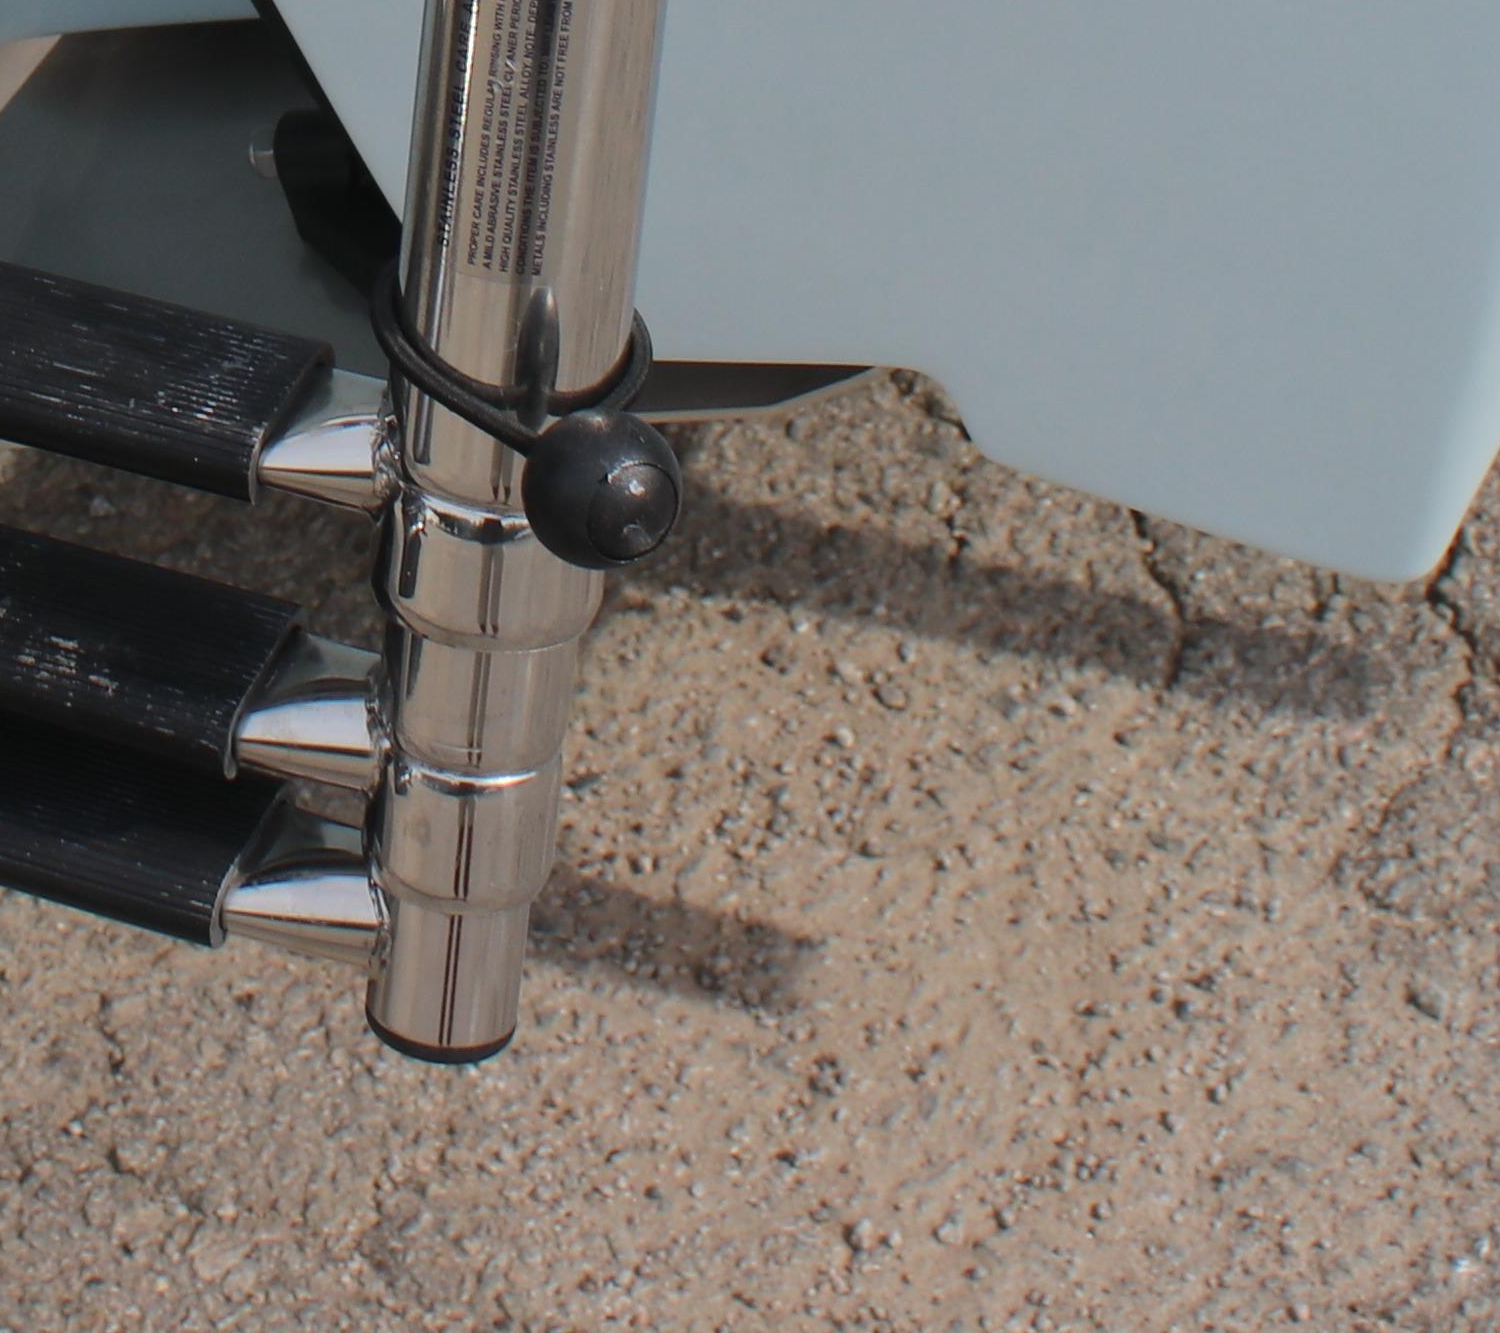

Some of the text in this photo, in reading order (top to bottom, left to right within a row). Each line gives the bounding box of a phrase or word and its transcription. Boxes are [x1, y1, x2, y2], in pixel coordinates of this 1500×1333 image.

[494, 2, 505, 30] WITH
[560, 0, 573, 32] FROM
[457, 20, 474, 73] CARE
[489, 32, 502, 77] RINSING
[504, 30, 518, 83] CLANER
[557, 33, 569, 62] FREE
[554, 63, 565, 87] NOT
[450, 84, 467, 140] STEEL
[483, 78, 497, 132] REGULAR
[500, 85, 512, 117] STEEL
[516, 103, 527, 136] STEEL
[532, 78, 547, 143] SUBJECTED
[552, 88, 563, 112] ARE
[476, 132, 491, 187] INCLUDES
[493, 119, 508, 177] STAINLESS
[530, 143, 539, 156] IS
[545, 112, 560, 172] STAINLESS
[509, 137, 523, 197] STAINLESS
[527, 155, 538, 183] ITEM
[437, 145, 460, 247] STAINLESS
[473, 188, 484, 220] CARE
[487, 179, 501, 233] ABRASIVE
[524, 182, 535, 206] THE
[538, 172, 553, 232] INCLUDING
[468, 220, 481, 266] PROPER
[503, 197, 516, 245] QUALITY
[517, 207, 532, 276] CONDITIONS
[483, 259, 492, 269] A
[484, 234, 495, 261] MILD
[500, 246, 511, 274] HIGH
[533, 233, 546, 277] METALS
